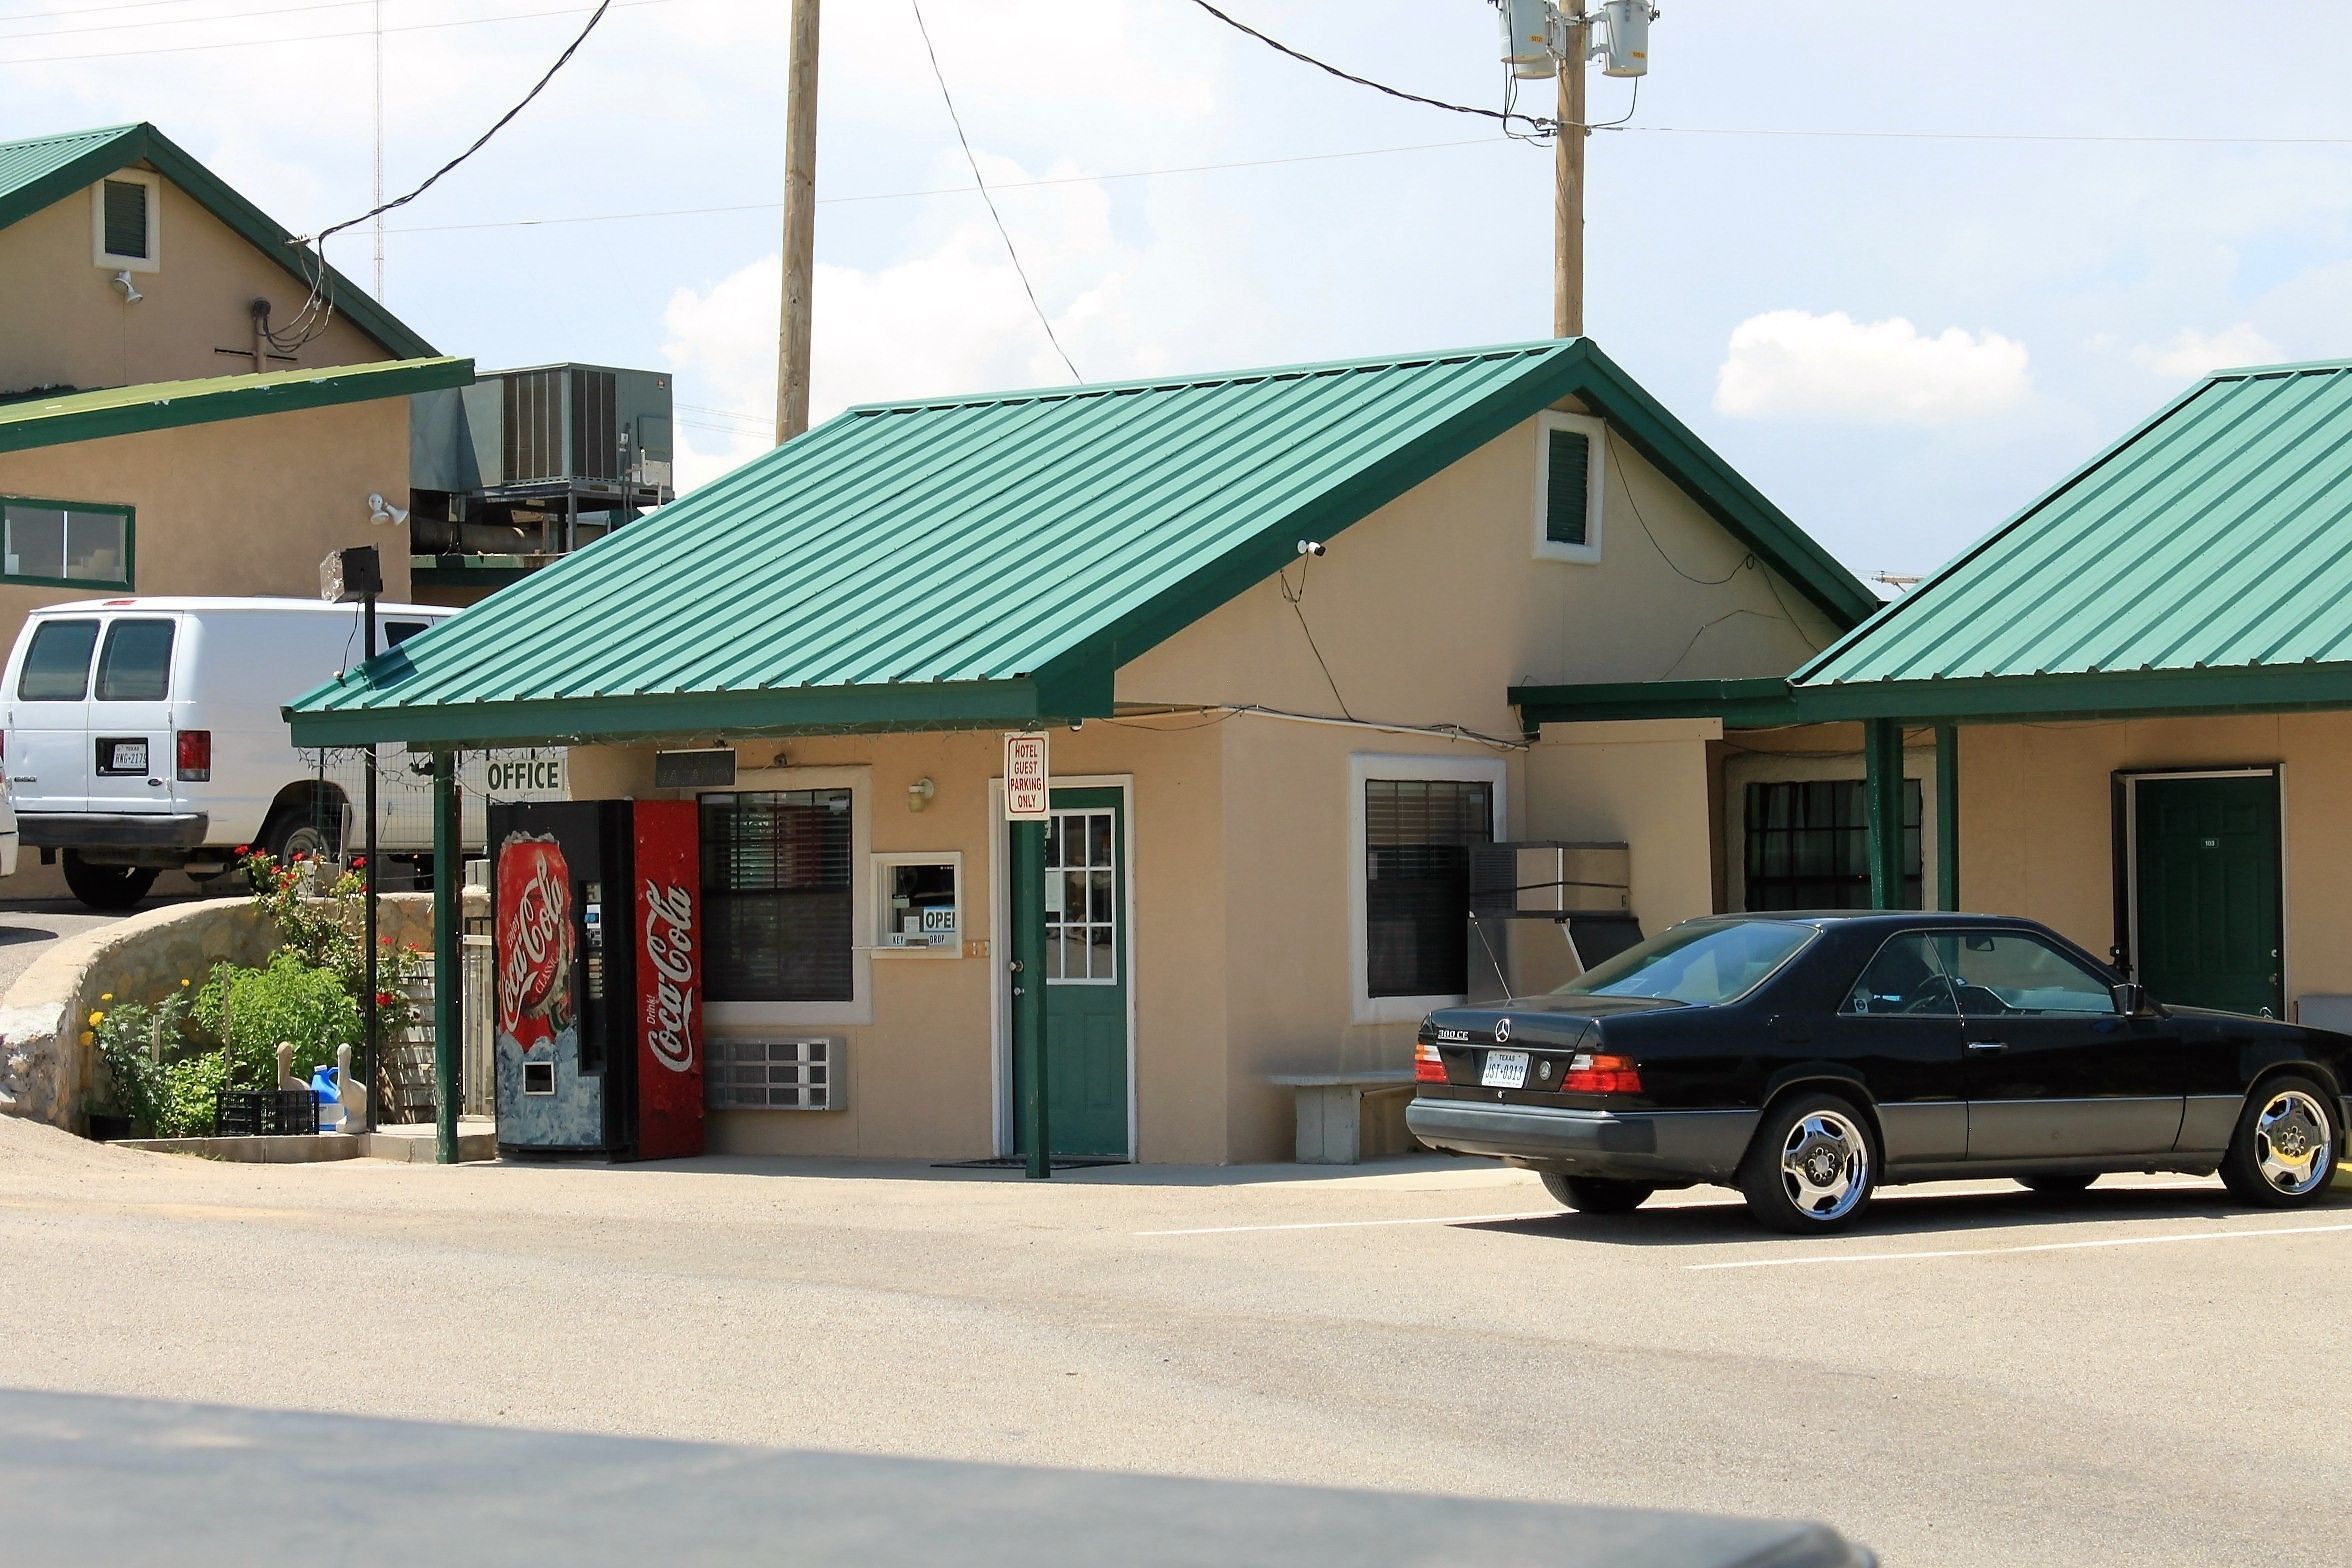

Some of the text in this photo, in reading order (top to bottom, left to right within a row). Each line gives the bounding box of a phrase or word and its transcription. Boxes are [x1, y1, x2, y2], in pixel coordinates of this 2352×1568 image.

[1015, 744, 1038, 758] HOTEL
[1014, 761, 1038, 775] GUEST
[487, 762, 559, 790] OFFICE
[1010, 778, 1042, 791] PARKING
[1017, 794, 1037, 809] ONLY
[502, 850, 564, 1034] Coca-Cola
[929, 935, 945, 945] DROP
[535, 951, 561, 995] CLASSIC
[647, 879, 693, 1072] Coca-Cola
[646, 994, 656, 1025] Drink!
[1499, 1054, 1516, 1062] TEXAS
